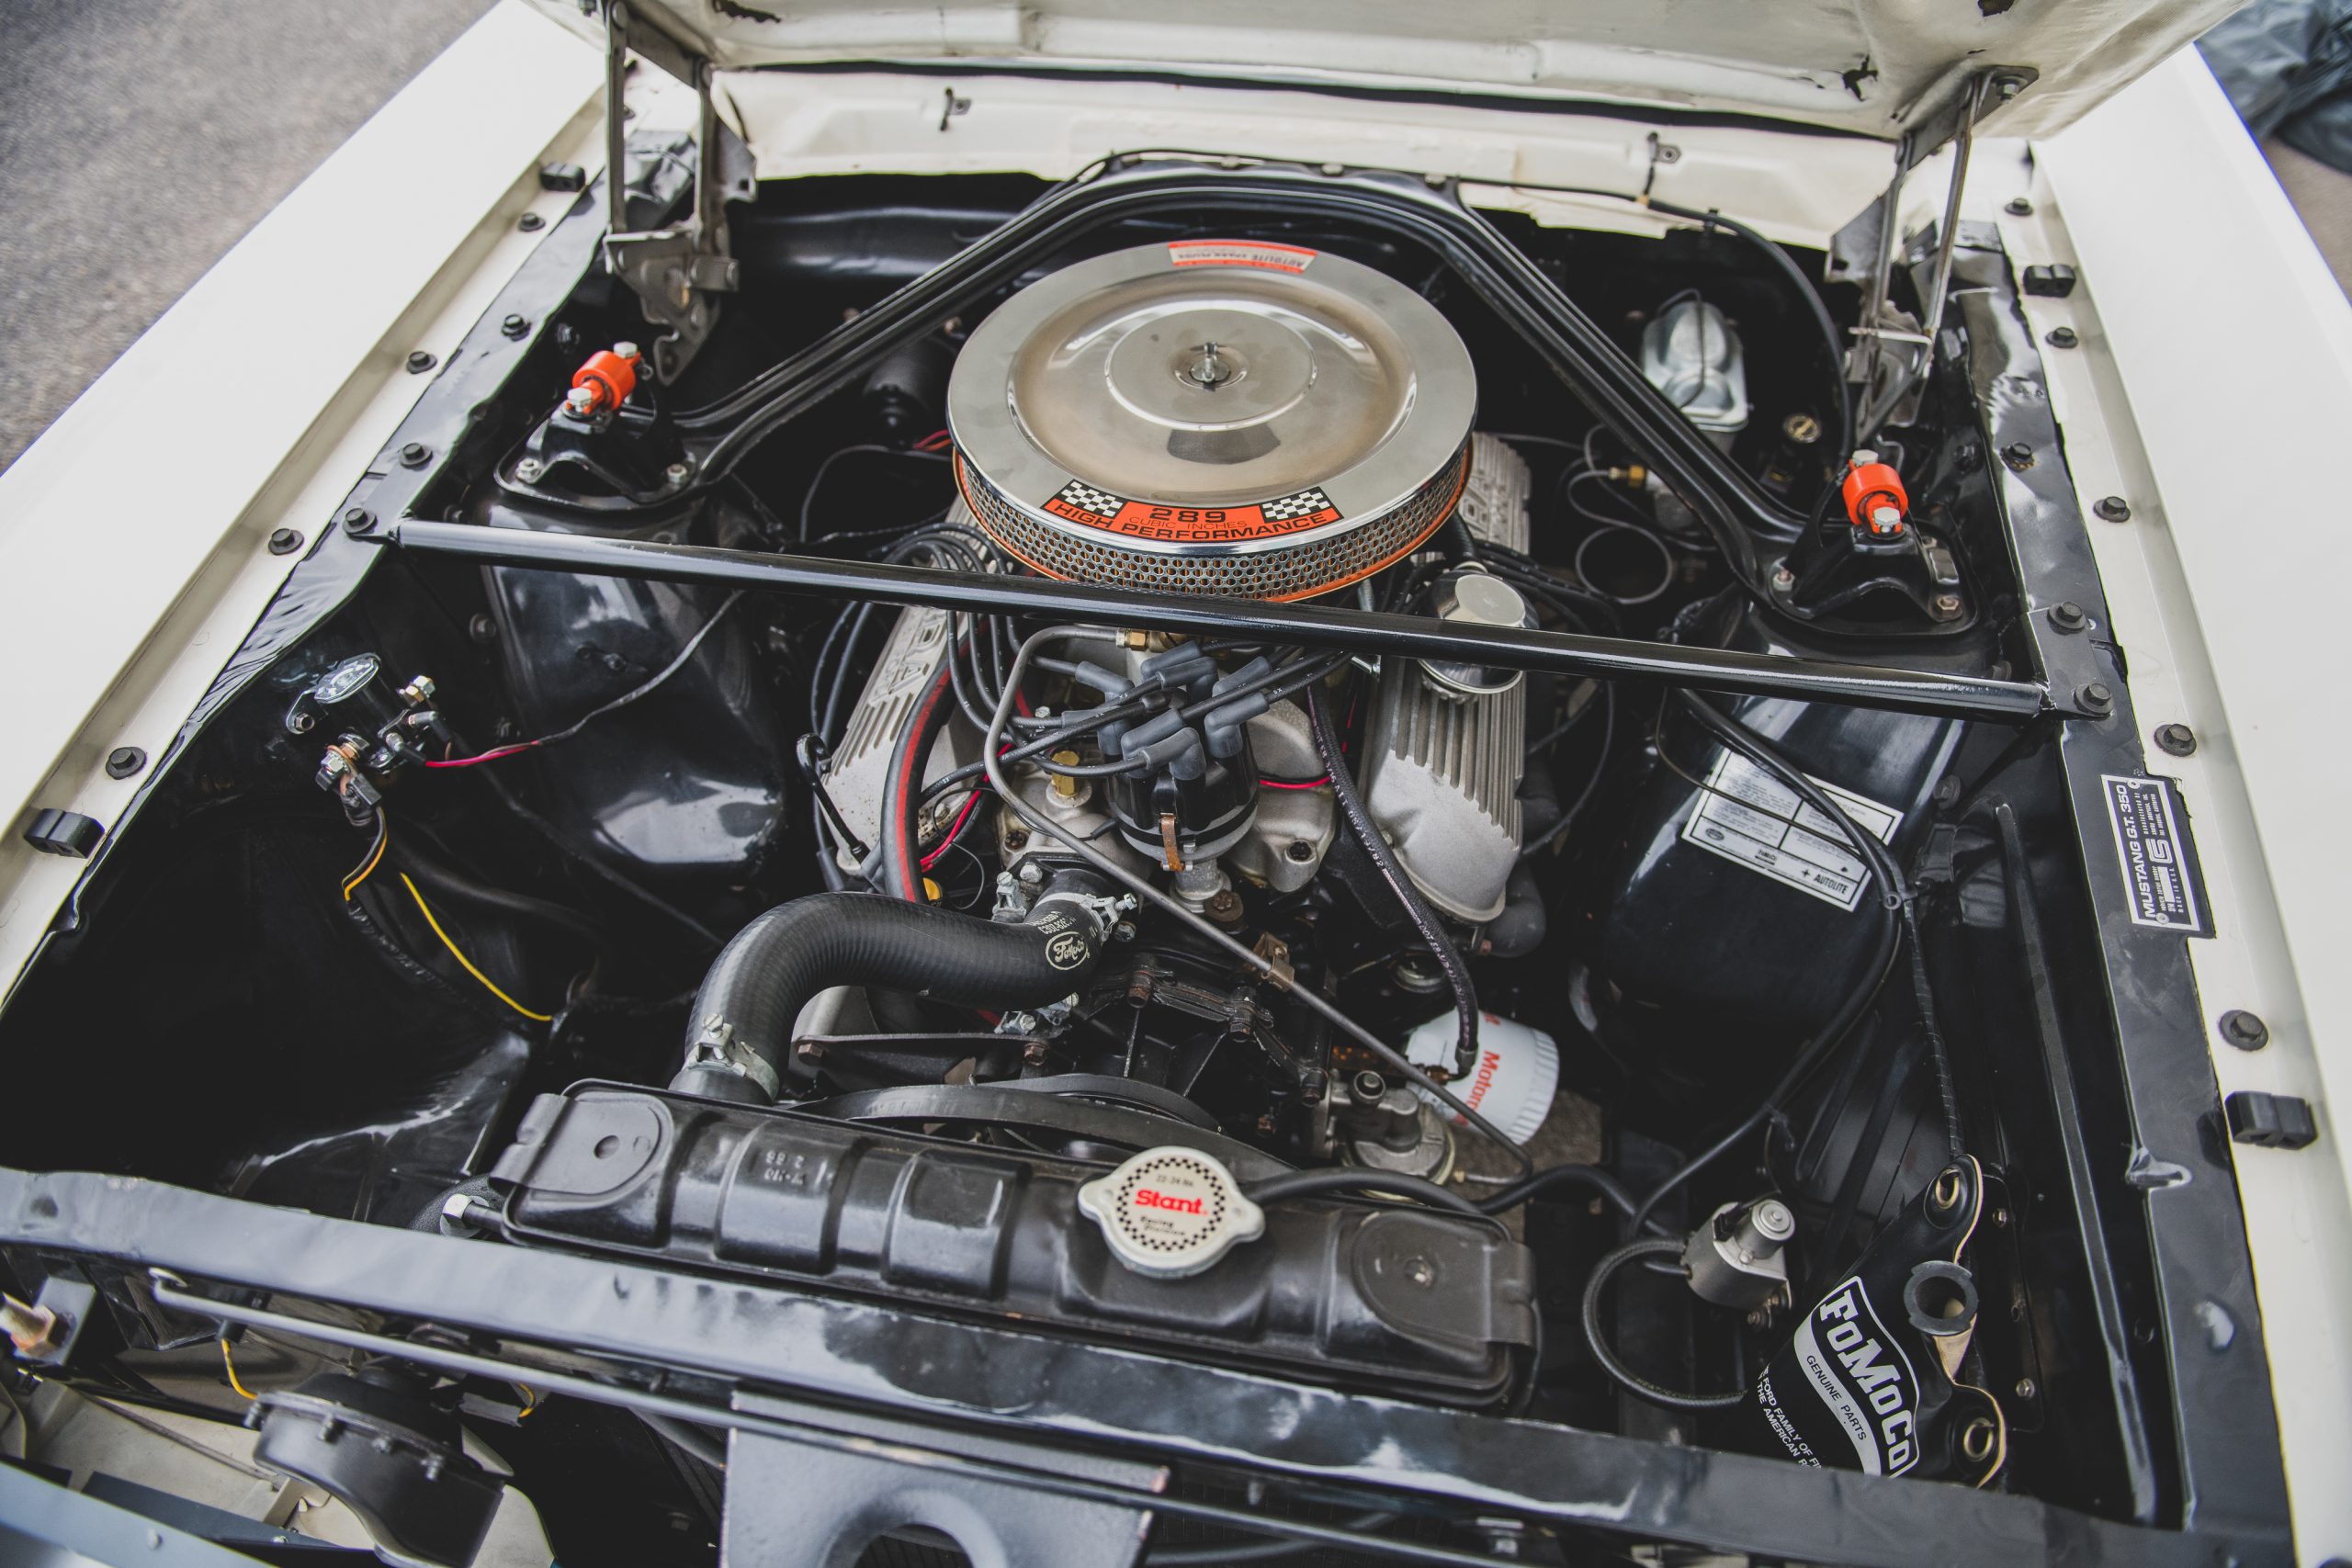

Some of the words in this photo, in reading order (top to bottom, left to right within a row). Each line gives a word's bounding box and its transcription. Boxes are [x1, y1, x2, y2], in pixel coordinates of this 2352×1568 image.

[1054, 503, 1115, 529] HIGH
[1121, 513, 1329, 540] PERFORMANCE
[1129, 516, 1177, 529] CUBIC
[1186, 520, 1248, 530] INCHES
[1150, 507, 1227, 523] 289
[2116, 784, 2132, 813] 350
[2123, 816, 2138, 840] G.T.
[1814, 874, 1849, 895] AUTOLITE
[2130, 840, 2155, 918] MUSTANG
[1454, 1050, 1500, 1126] Motorc
[1135, 1188, 1204, 1215] Stant
[1805, 1355, 1842, 1401] GENUINE
[1840, 1404, 1867, 1440] PARTS
[1819, 1289, 1913, 1470] FoMoCo
[1757, 1381, 1768, 1404] THE
[1763, 1407, 1801, 1457] AMERICAN
[1763, 1377, 1777, 1406] FORD
[1774, 1407, 1802, 1440] FAMILY
[1798, 1443, 1814, 1456] OF
